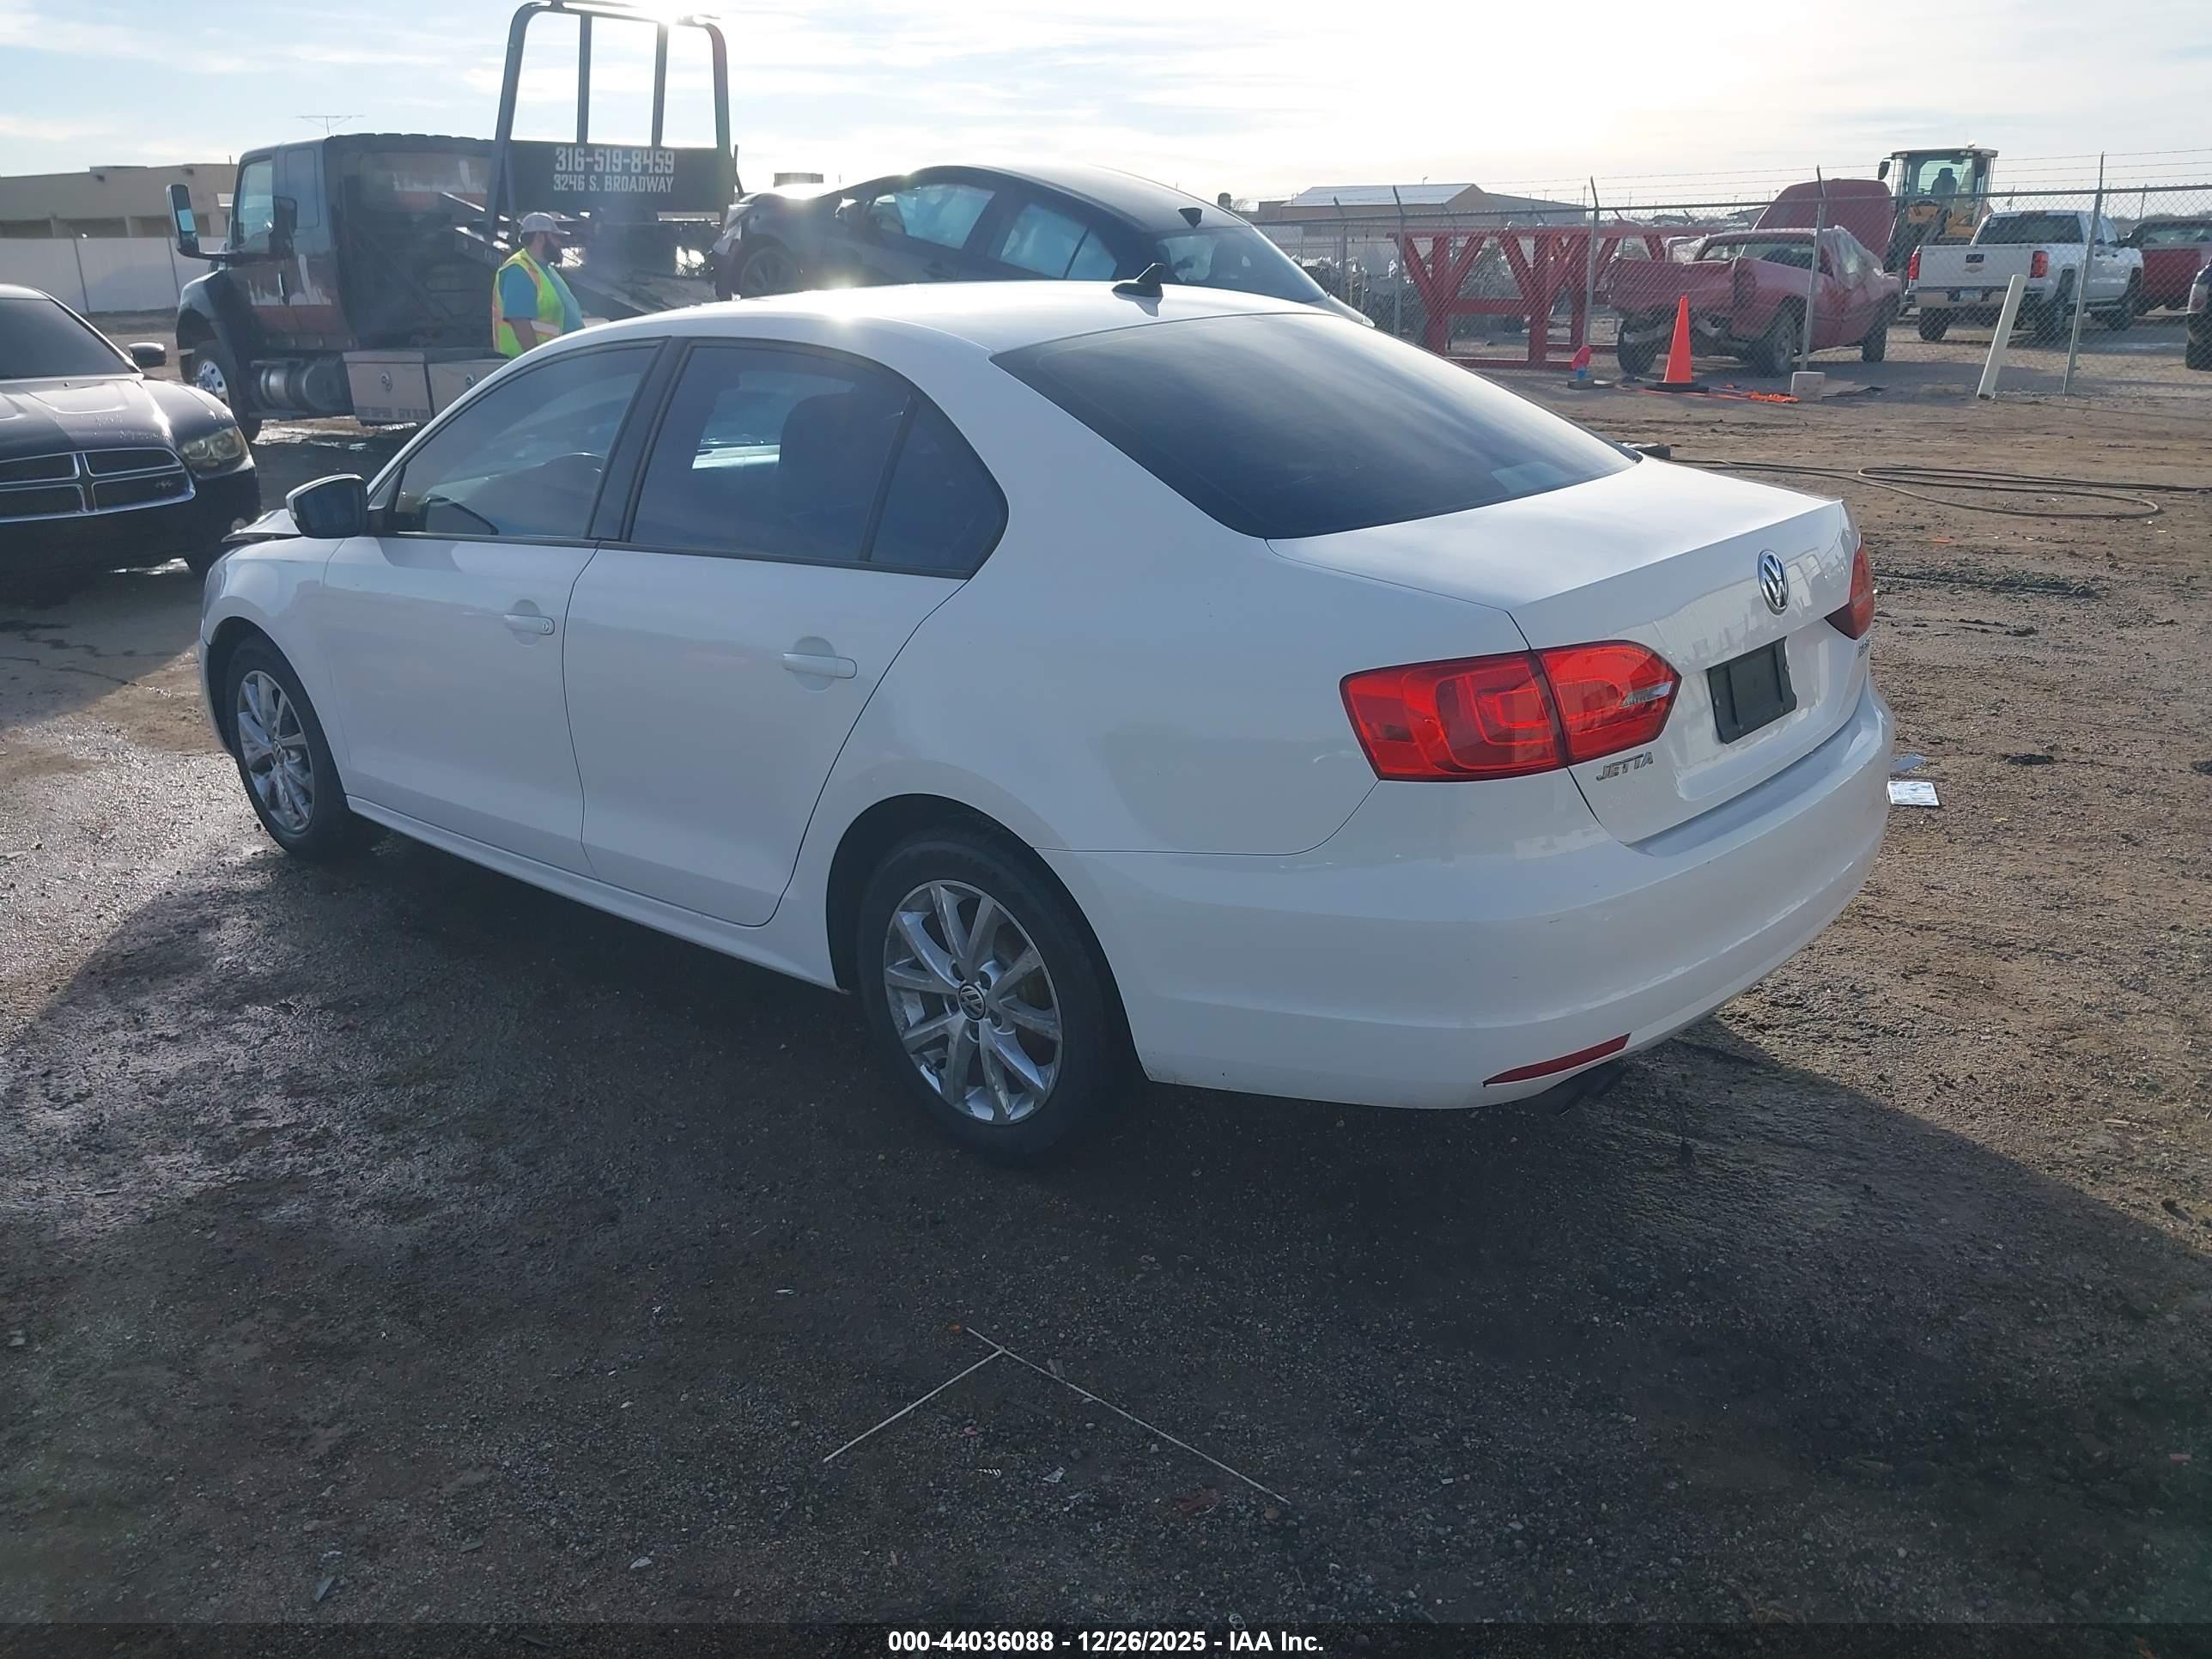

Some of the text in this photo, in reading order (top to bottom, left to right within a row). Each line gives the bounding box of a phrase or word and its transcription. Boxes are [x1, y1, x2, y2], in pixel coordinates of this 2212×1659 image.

[556, 147, 675, 173] 316-519-8459
[553, 173, 674, 193] 3246 S. BROADWAY
[1595, 751, 1654, 781] JETTA
